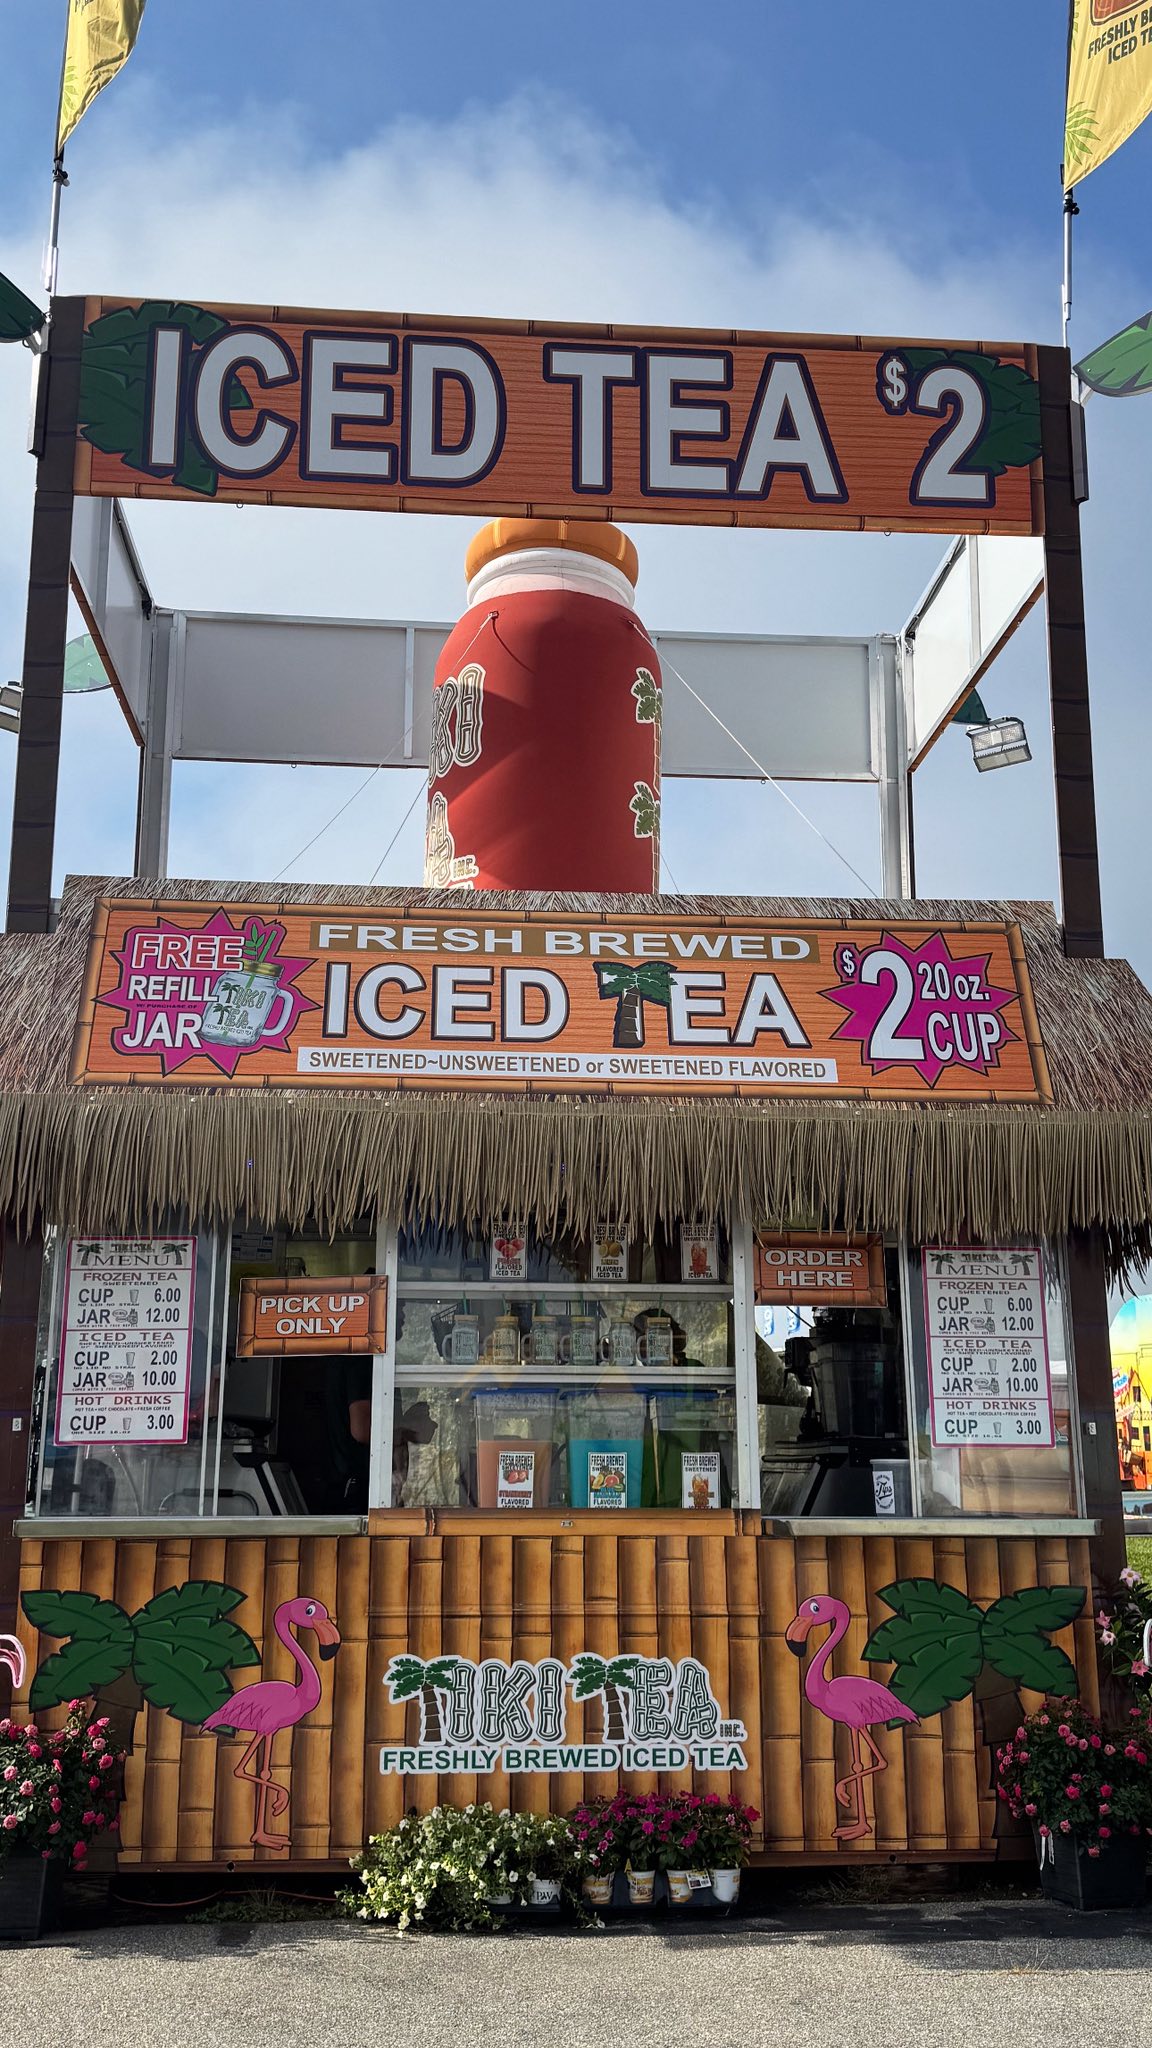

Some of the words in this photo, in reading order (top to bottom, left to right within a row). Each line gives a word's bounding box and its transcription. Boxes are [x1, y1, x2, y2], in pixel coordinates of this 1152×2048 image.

[1088, 14, 1138, 59] FRESHLY
[1108, 36, 1138, 65] ICED
[145, 324, 502, 482] ICED
[549, 349, 843, 498] TEA
[318, 924, 524, 954] FRESH
[544, 929, 811, 960] BREWED
[131, 933, 245, 971] FREE
[128, 975, 219, 1002] REFILL
[917, 961, 951, 1001] 20
[953, 974, 991, 1002] oz.
[325, 962, 569, 1043] ICED
[593, 961, 812, 1048] TEA
[213, 1003, 249, 1029] TEA
[122, 1011, 202, 1048] JAR
[926, 1010, 1001, 1063] CUP
[586, 1062, 605, 1073] or
[609, 1057, 724, 1077] SWEETENED
[728, 1060, 827, 1080] FLAVORED
[92, 1255, 171, 1266] MENU
[764, 1249, 864, 1268] ORDER
[83, 1272, 142, 1281] FROZEN
[147, 1272, 178, 1281] TEA
[947, 1264, 1018, 1276] MENU
[776, 1270, 854, 1288] HERE
[940, 1281, 994, 1290] FROZEN
[999, 1282, 1028, 1291] TEA
[78, 1288, 114, 1303] CUP
[154, 1288, 181, 1303] 6.00
[937, 1296, 970, 1311] CUP
[1007, 1297, 1033, 1312] 6.00
[259, 1296, 321, 1315] PICK
[328, 1295, 365, 1314] UP
[77, 1309, 111, 1324] JAR
[146, 1308, 180, 1323] 12.00
[939, 1316, 970, 1331] JAR
[1002, 1316, 1034, 1331] 12.00
[275, 1317, 347, 1336] ONLY
[79, 1332, 127, 1342] ICED
[140, 1332, 175, 1341] TEA
[943, 1339, 987, 1348] ICED
[998, 1339, 1032, 1349] TEA
[74, 1351, 110, 1366] CUP
[150, 1350, 178, 1365] 2.00
[941, 1357, 973, 1372] CUP
[1011, 1358, 1037, 1373] 2.00
[73, 1372, 107, 1388] JAR
[142, 1371, 176, 1386] 10.00
[942, 1377, 974, 1392] JAR
[1006, 1377, 1039, 1392] 10.00
[74, 1396, 104, 1405] HOT
[114, 1395, 172, 1405] DRINKS
[946, 1401, 973, 1410] HOT
[982, 1401, 1037, 1411] DRINKS
[70, 1415, 107, 1431] CUP
[147, 1414, 174, 1429] 3.00
[944, 1419, 978, 1434] CUP
[1016, 1420, 1041, 1435] 3.00
[500, 1454, 514, 1466] FRESH
[591, 1455, 605, 1466] FRESH
[606, 1455, 624, 1466] BREWED
[683, 1455, 698, 1466] FRESH
[699, 1455, 717, 1467] BREWED
[385, 1655, 565, 1742] TIKI
[569, 1654, 718, 1742] TEA
[720, 1723, 744, 1737] INC.
[383, 1748, 497, 1771] FRESHLY
[506, 1748, 619, 1769] BREWED
[626, 1747, 685, 1768] ICED
[694, 1746, 744, 1767] TEA
